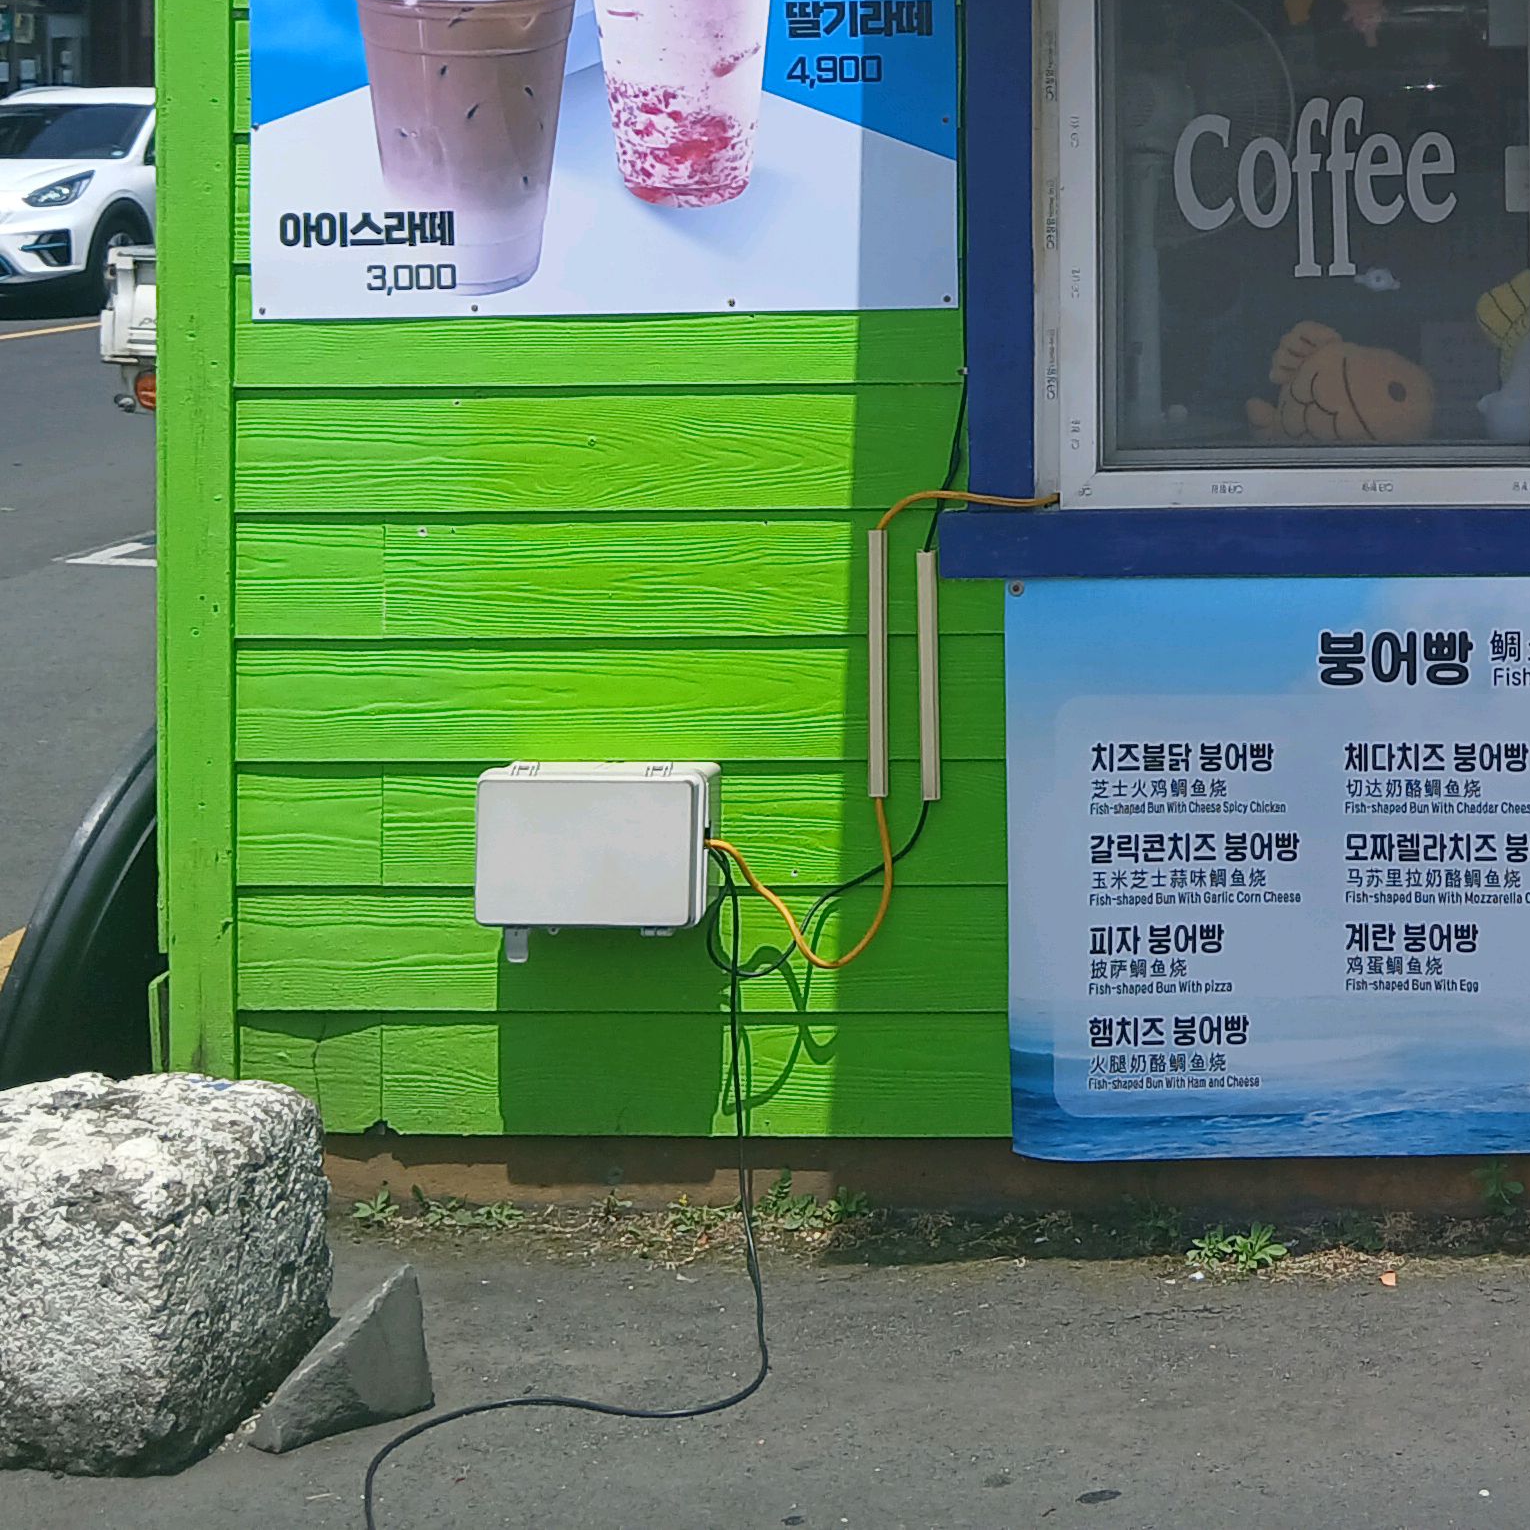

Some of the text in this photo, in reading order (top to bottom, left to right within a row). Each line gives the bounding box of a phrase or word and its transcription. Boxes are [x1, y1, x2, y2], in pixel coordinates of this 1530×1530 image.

[785, 0, 932, 38] 딸기라떼
[787, 56, 882, 87] 4,900
[1174, 96, 1457, 278] Coffee
[279, 212, 455, 247] 아이스라떼
[366, 264, 456, 292] 3,000
[1318, 631, 1473, 685] 붕어빵
[1091, 743, 1273, 772] 치즈불닭 붕어빵
[1345, 743, 1528, 772] 체다치즈 붕어빵
[1091, 779, 1227, 799] 芝士火鸡鲷鱼烧
[1346, 779, 1481, 798] 切达奶酪鲷鱼烧
[1091, 833, 1299, 864] 갈릭콘치즈 붕어빵
[1346, 833, 1498, 862] 모짜렐라치즈
[1092, 868, 1266, 890] 玉米芝士蒜味鲷鱼烧
[1346, 869, 1521, 888] 马苏里拉奶酪鲷鱼烧
[1090, 892, 1301, 906] Fish-shaped Bun With Garlic Corn Cheese
[1346, 892, 1411, 905] Fish-shaped
[1415, 892, 1435, 905] Bun
[1438, 892, 1462, 905] With
[1465, 892, 1522, 905] Mozzarella
[1090, 924, 1224, 955] 피자 붕어빵
[1346, 924, 1478, 952] 계란 붕어빵
[1091, 959, 1187, 979] 披萨鲷鱼烧
[1347, 956, 1443, 975] 鸡蛋鲷鱼烧
[1090, 1016, 1249, 1047] 햄치즈 붕어빵
[1091, 1054, 1226, 1074] 火腿奶酪鲷鱼烧
